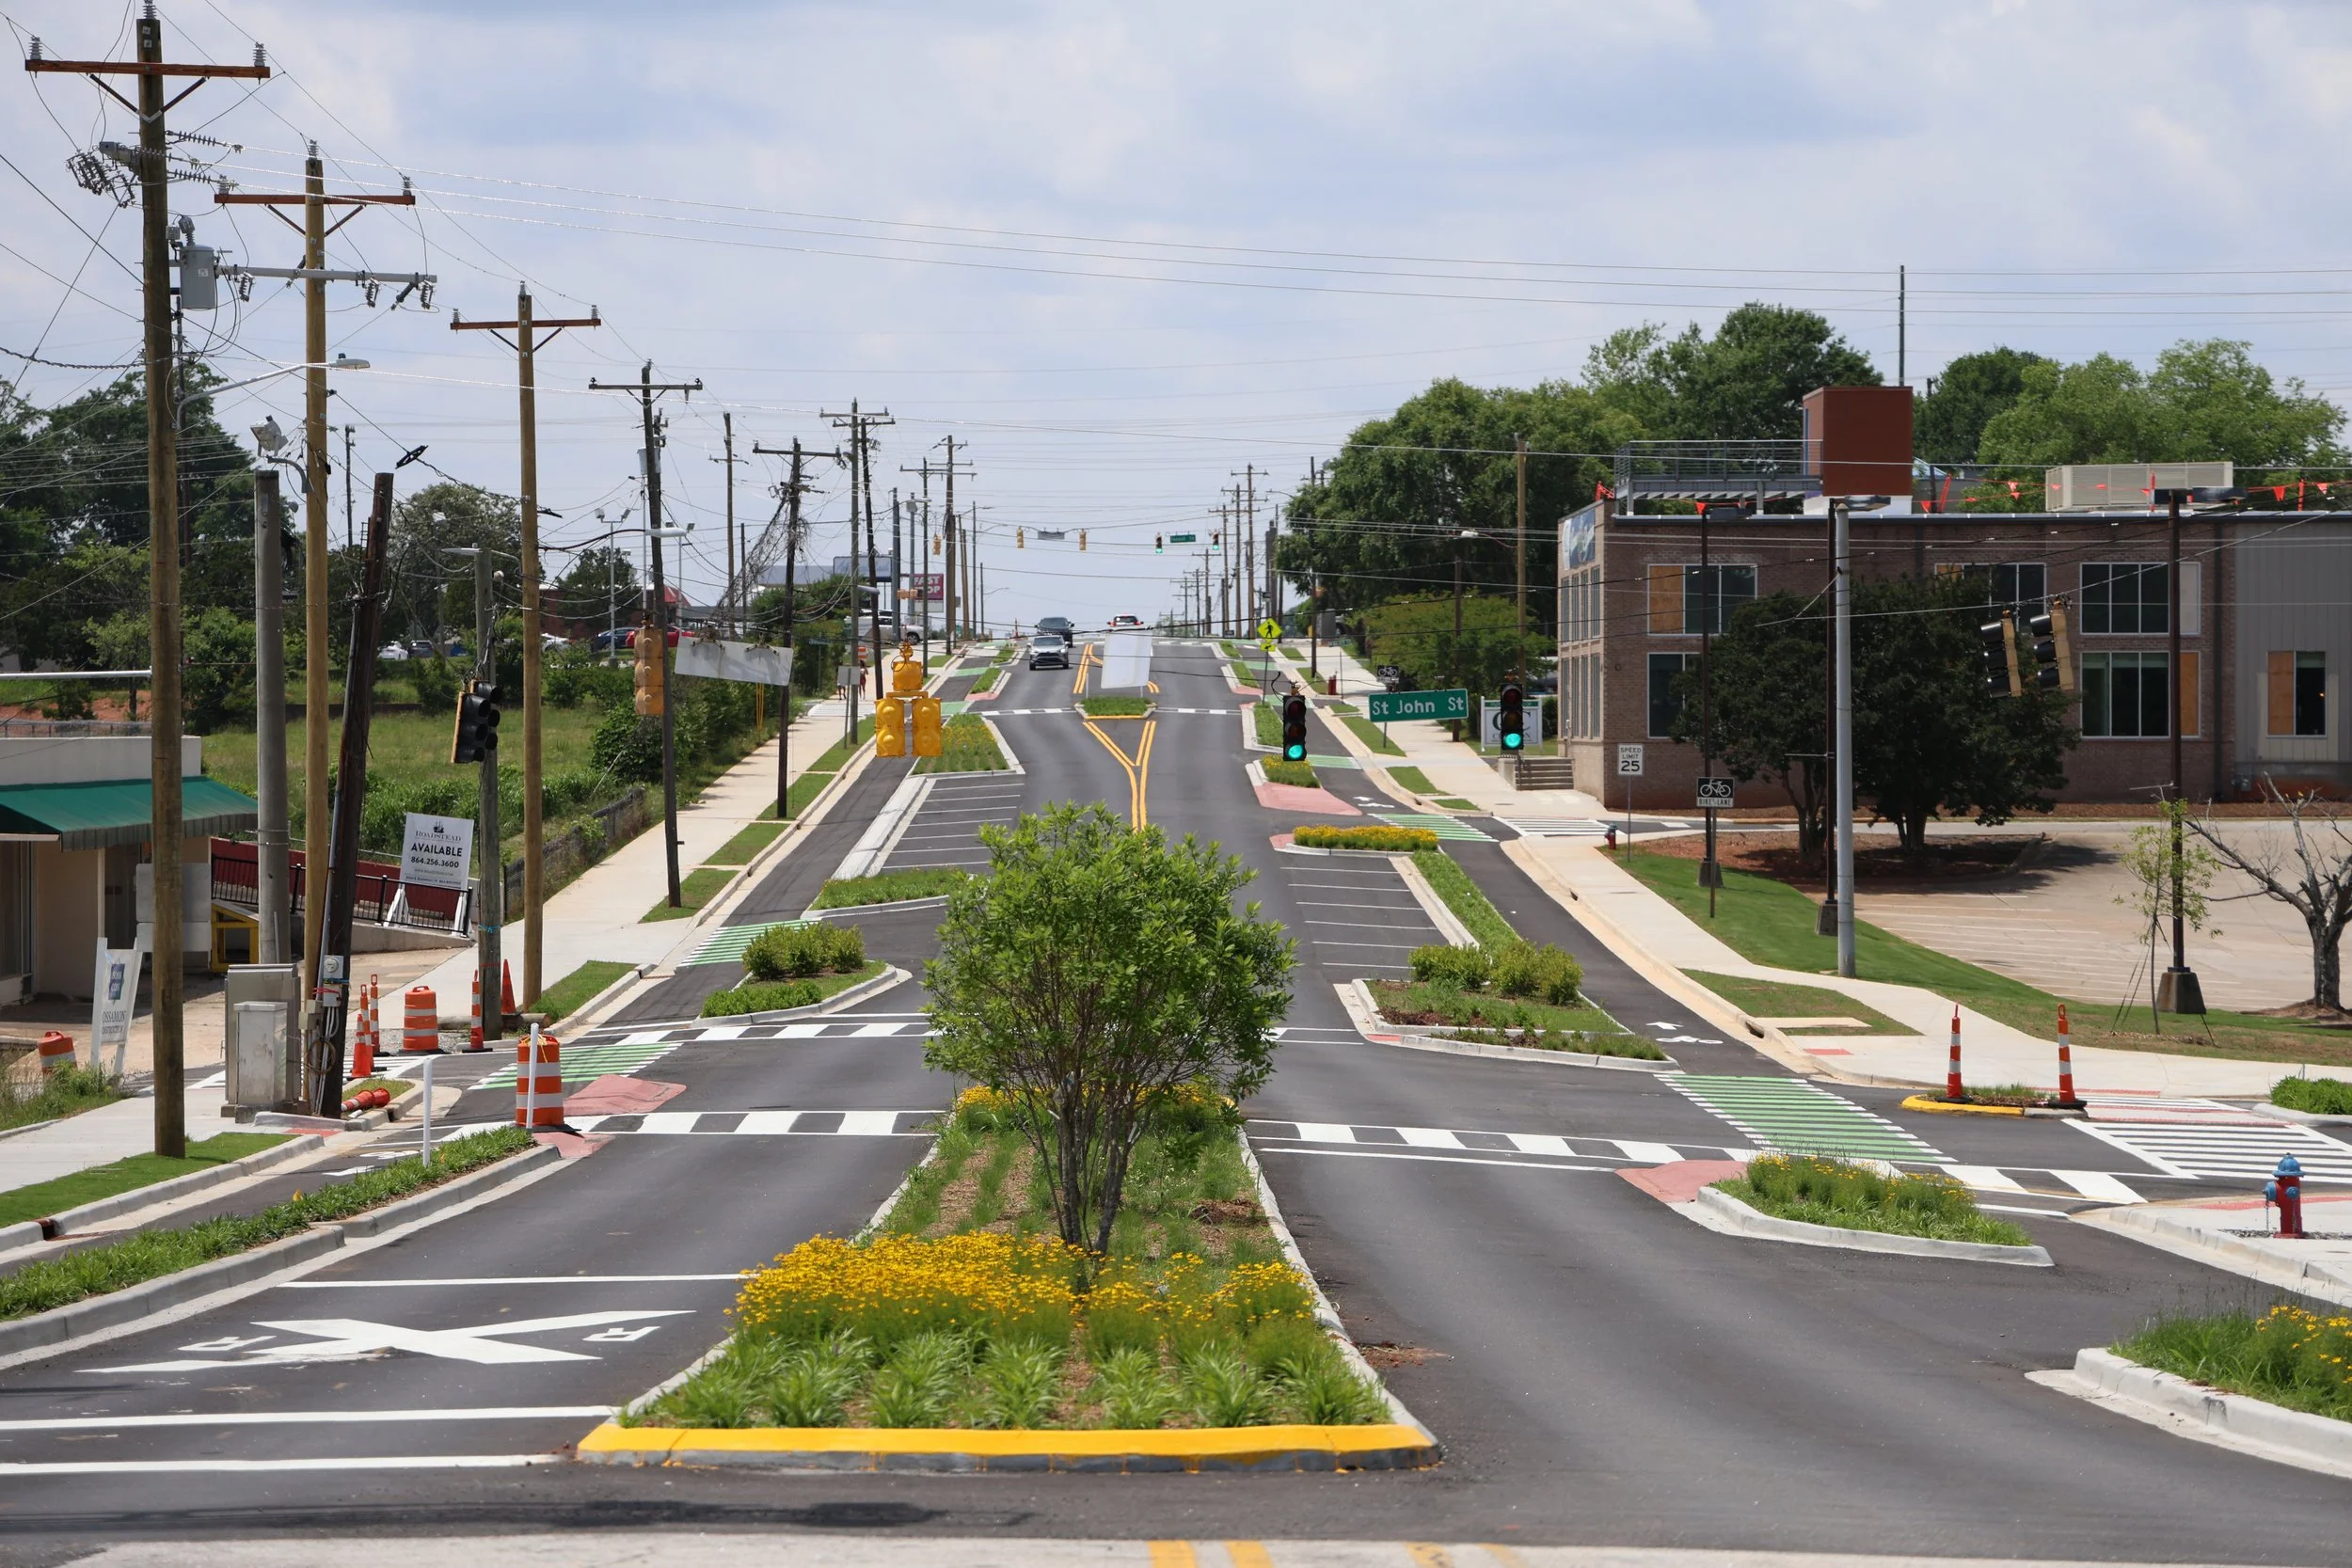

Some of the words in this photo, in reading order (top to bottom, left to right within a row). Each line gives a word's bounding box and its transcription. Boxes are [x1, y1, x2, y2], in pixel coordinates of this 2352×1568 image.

[914, 576, 941, 586] FAST
[1372, 701, 1389, 716] St
[1395, 700, 1436, 715] John
[1447, 696, 1464, 711] St
[1620, 760, 1641, 772] 25
[1698, 798, 1712, 806] BIKE
[1717, 798, 1732, 806] LANE
[415, 830, 462, 842] ROADSTEAD
[410, 842, 463, 857] AVAILABLE
[410, 856, 460, 868] 864.256.3600
